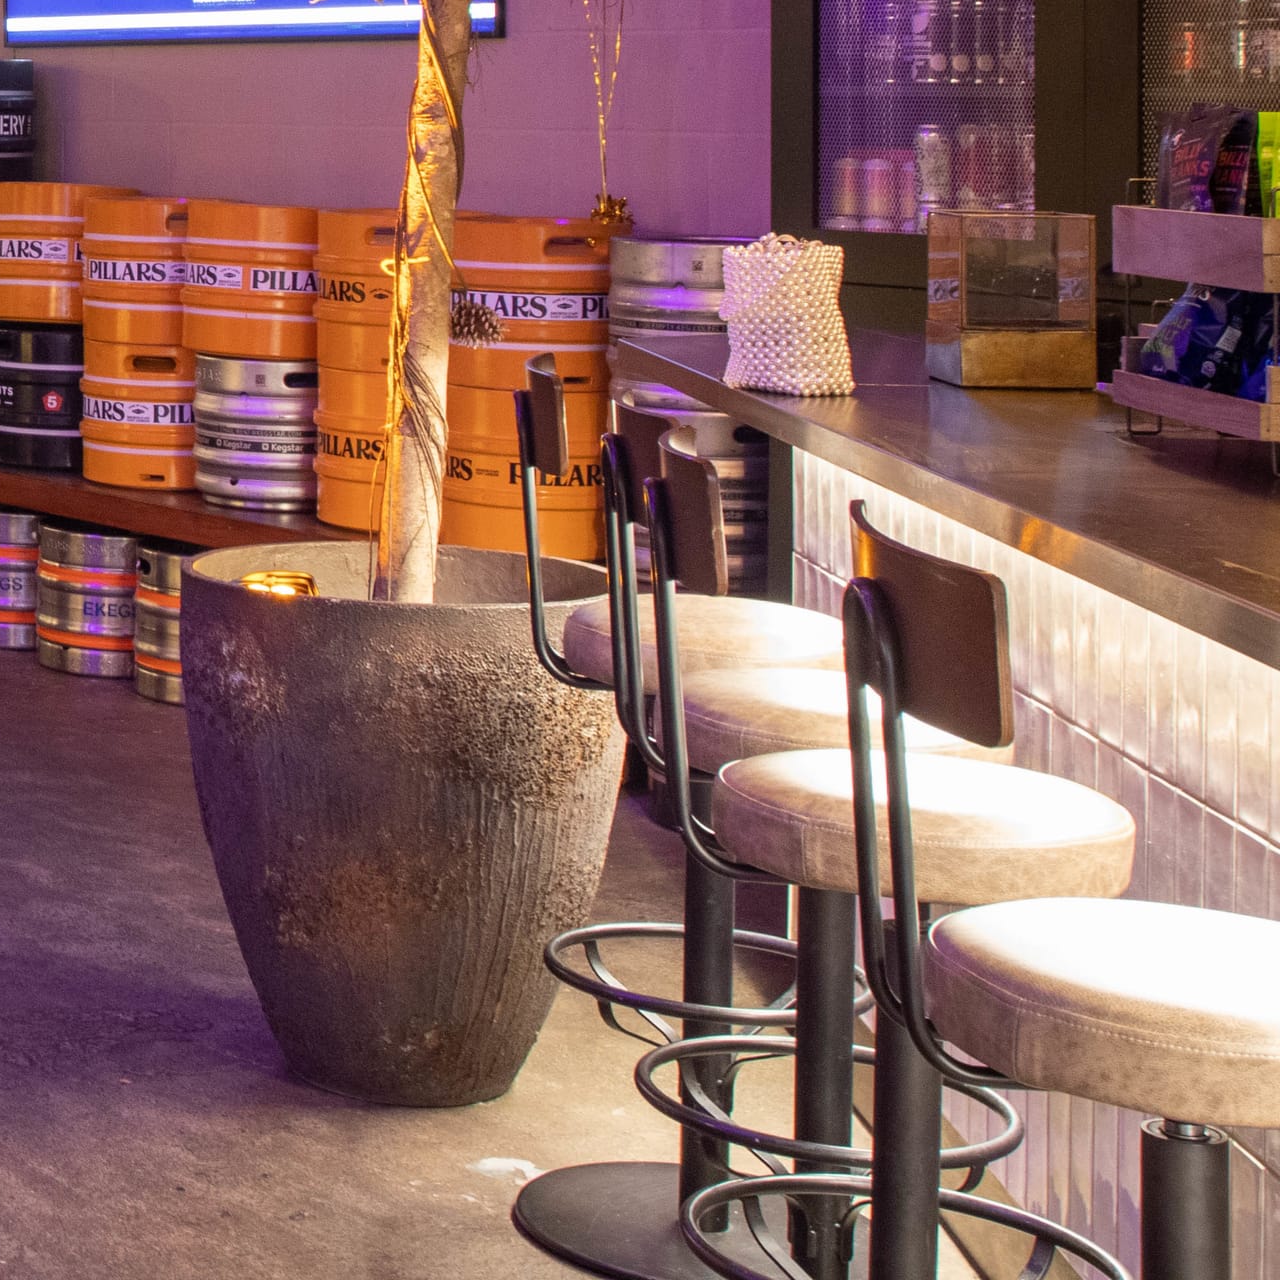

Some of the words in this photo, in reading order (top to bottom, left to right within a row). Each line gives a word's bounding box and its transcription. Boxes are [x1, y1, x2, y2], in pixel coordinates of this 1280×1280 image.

[90, 260, 166, 282] PILLARS
[47, 395, 58, 409] 5
[223, 439, 252, 450] Kegstar
[271, 442, 304, 454] Kegstar
